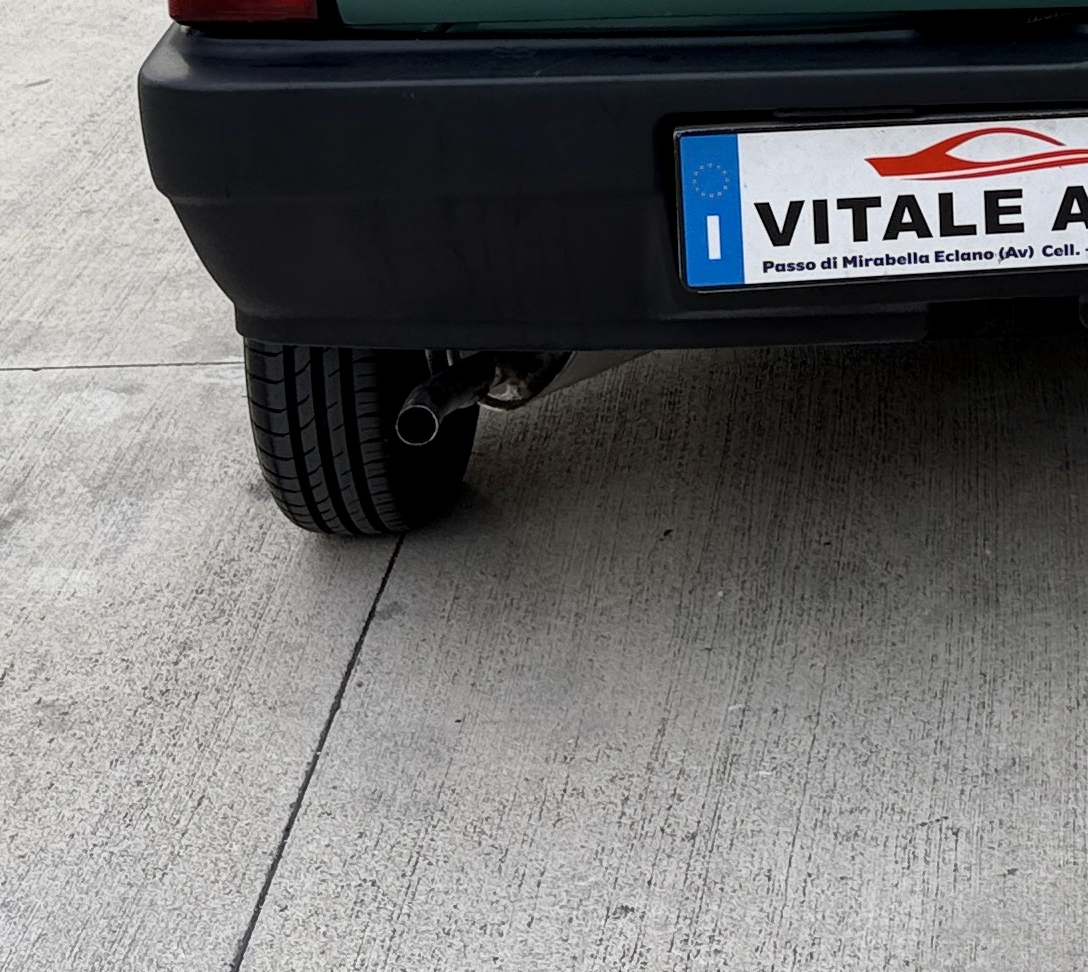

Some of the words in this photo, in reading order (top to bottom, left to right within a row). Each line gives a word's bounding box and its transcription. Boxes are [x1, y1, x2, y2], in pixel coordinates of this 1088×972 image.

[753, 188, 1026, 248] VITALE
[762, 260, 817, 274] Passo
[820, 256, 838, 270] di
[842, 251, 930, 269] Mirabella
[934, 249, 995, 263] Eclano
[999, 245, 1035, 260] (Av)
[1042, 243, 1081, 258] Cell.
